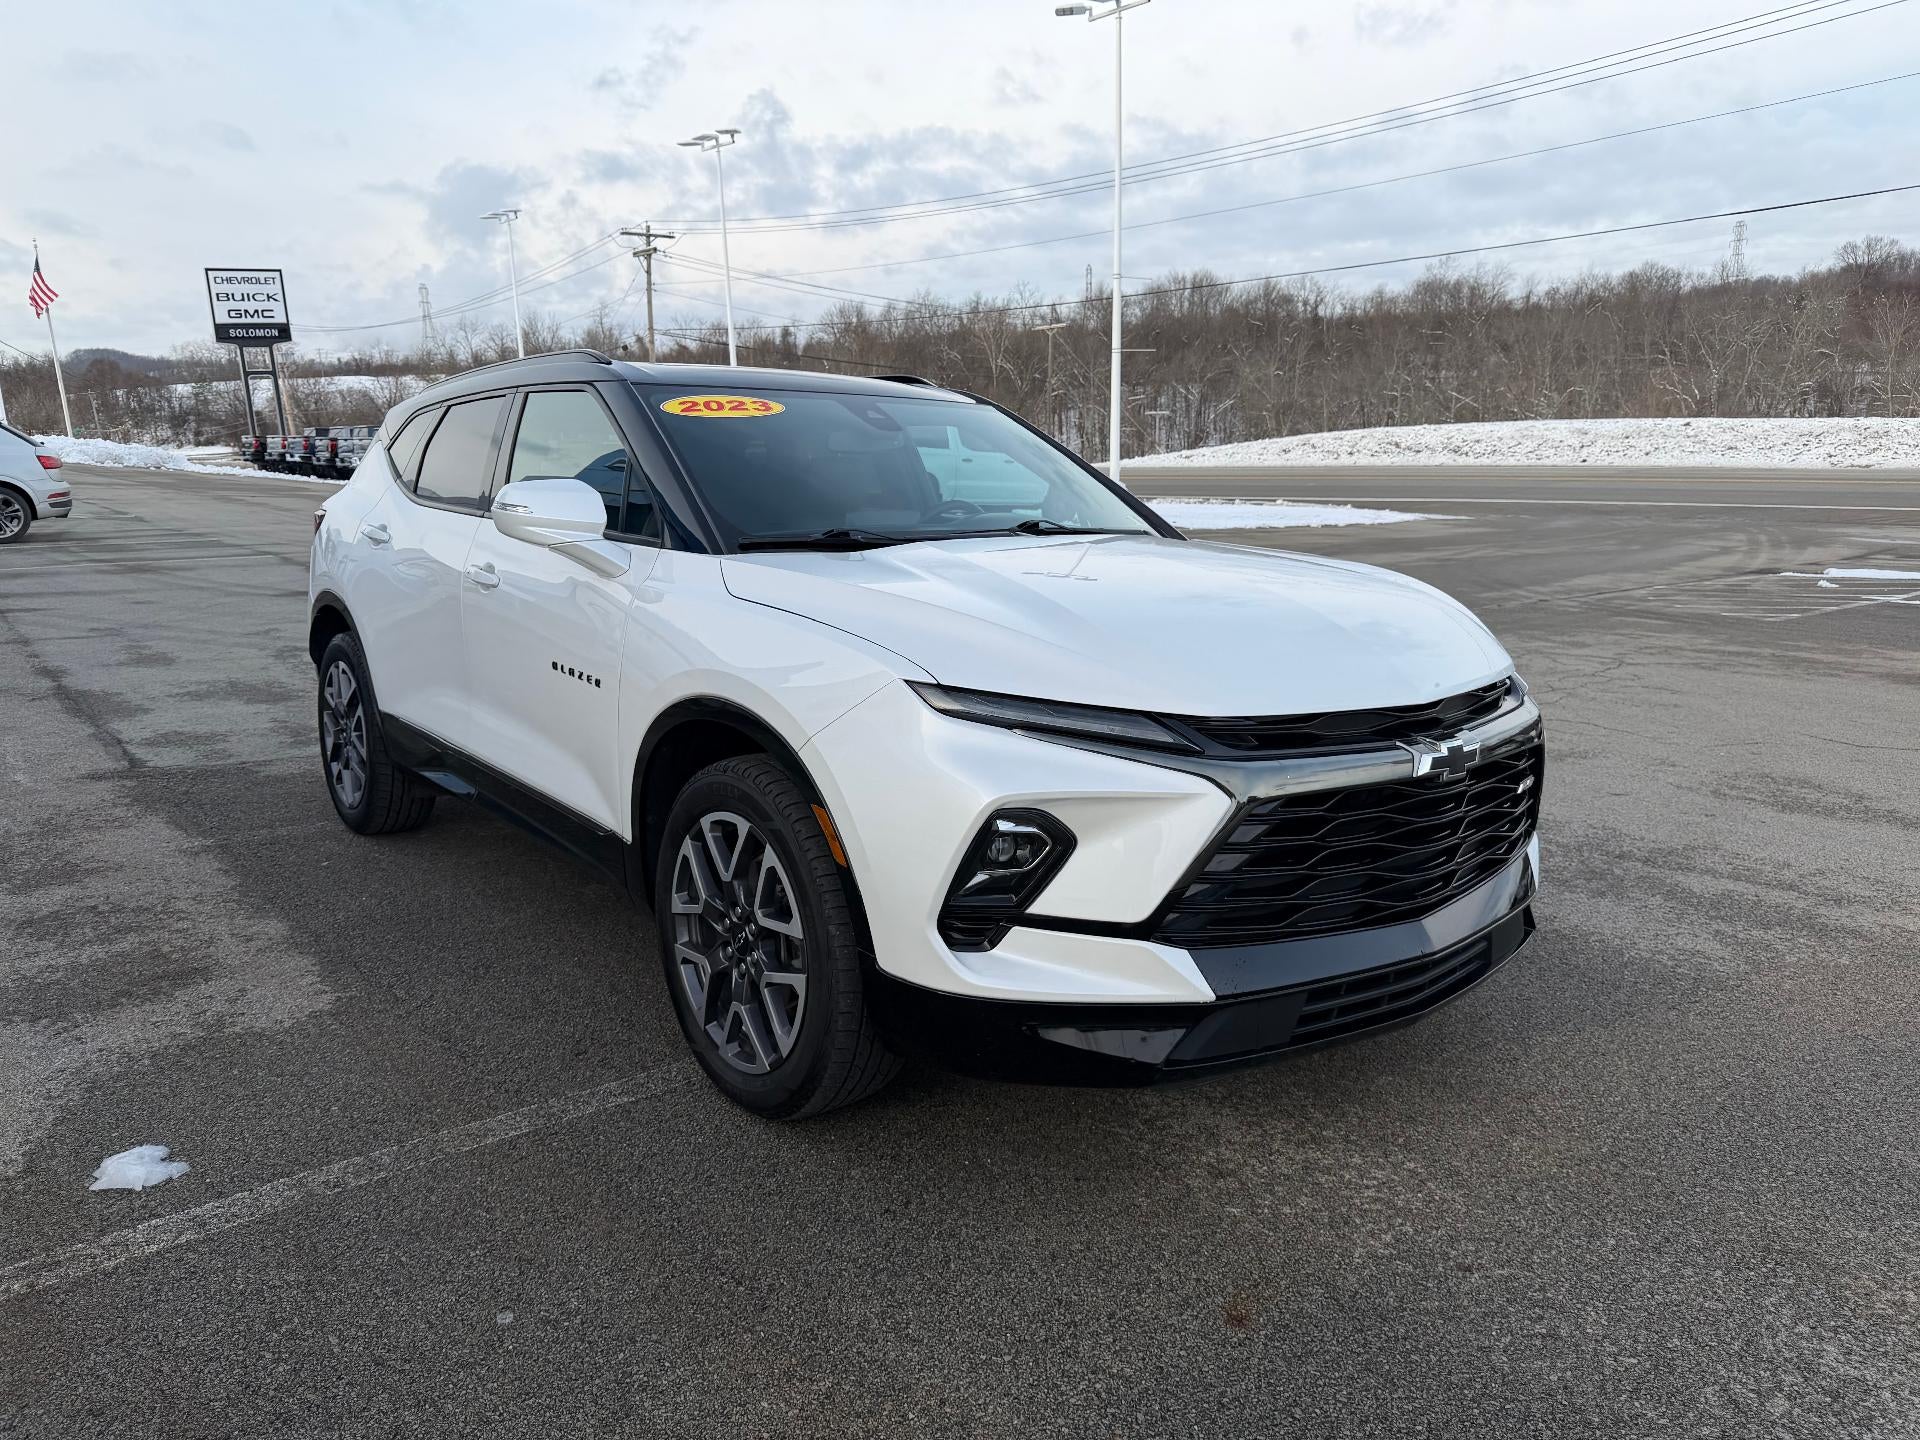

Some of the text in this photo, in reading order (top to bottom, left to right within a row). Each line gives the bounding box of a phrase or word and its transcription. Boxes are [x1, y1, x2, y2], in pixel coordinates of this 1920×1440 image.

[213, 276, 276, 285] CHEVROLET
[215, 292, 281, 302] BUICK
[227, 309, 275, 318] GMC
[229, 328, 279, 337] SOLOMON
[678, 400, 773, 412] 2023
[551, 660, 601, 689] BLAZER
